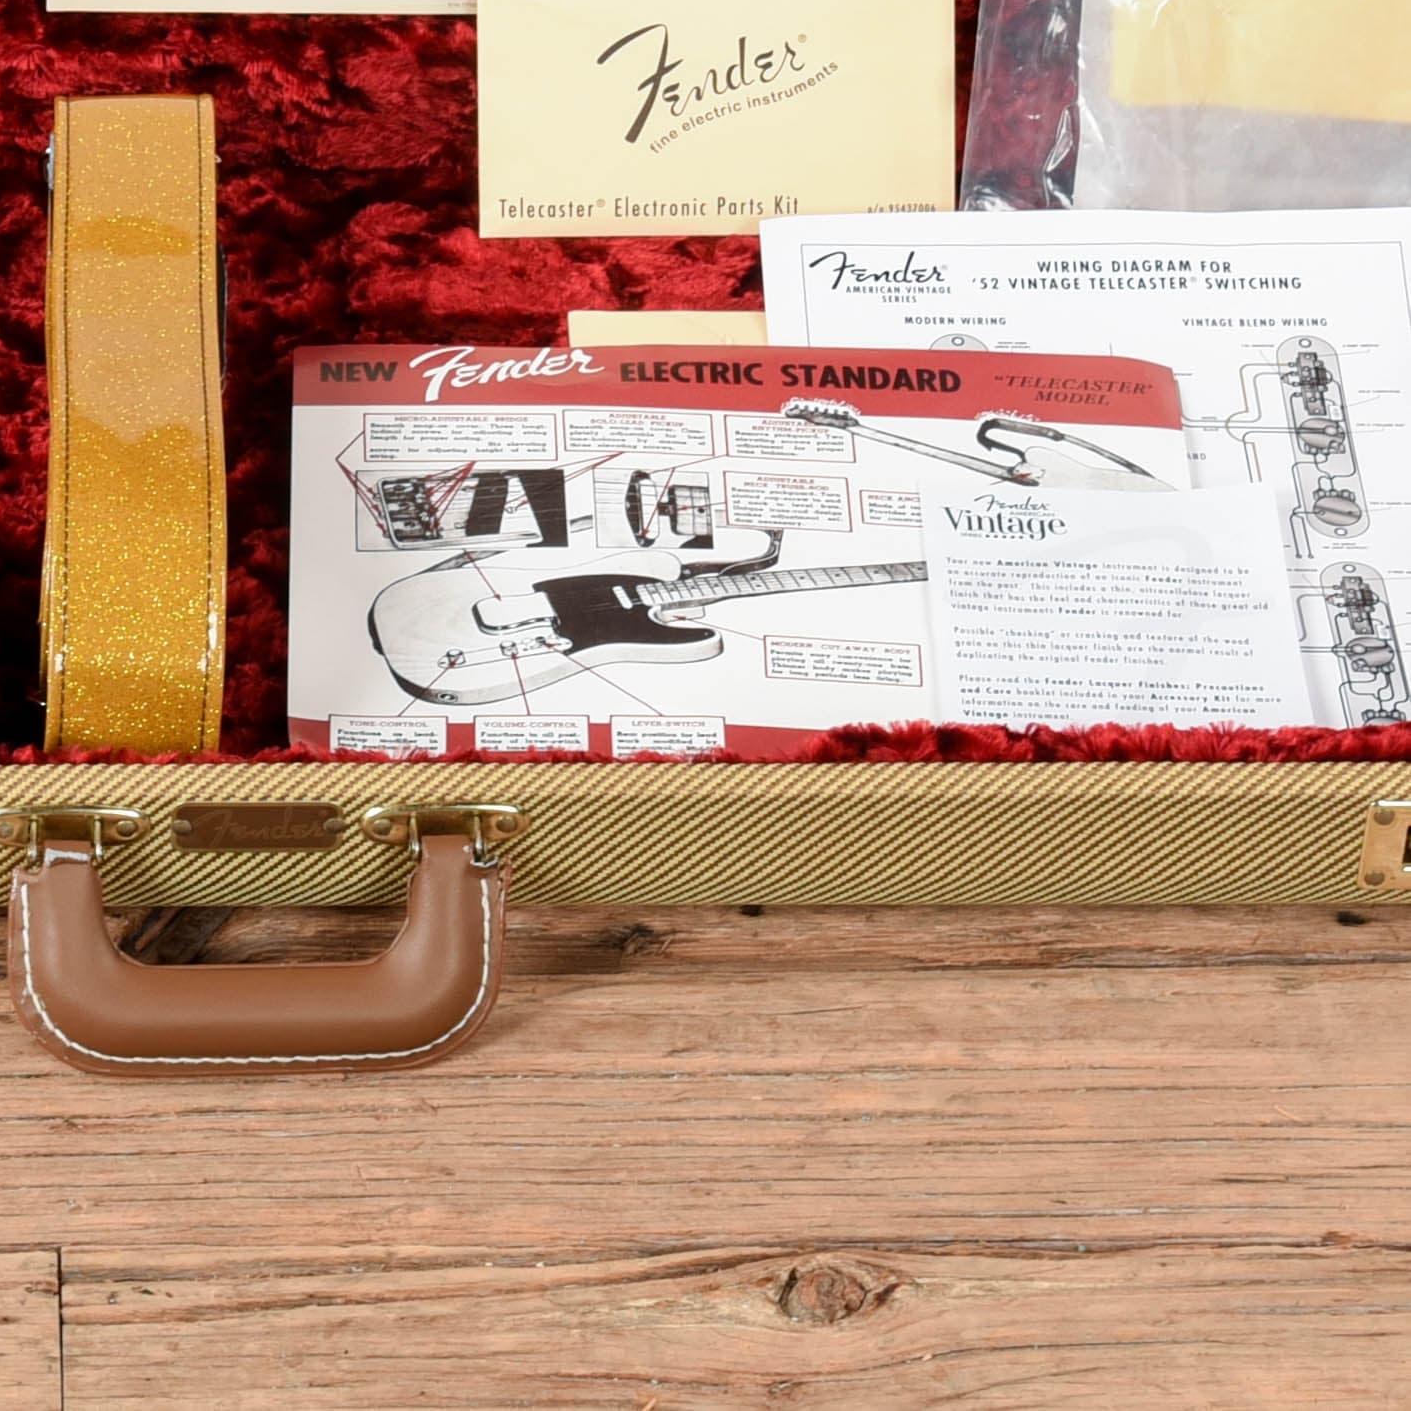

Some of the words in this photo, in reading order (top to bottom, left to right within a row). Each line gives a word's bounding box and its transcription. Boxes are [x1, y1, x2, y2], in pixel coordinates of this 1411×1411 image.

[648, 127, 678, 155] fine
[681, 99, 742, 133] electric
[746, 61, 840, 109] instruments
[613, 197, 710, 219] Electronic
[716, 196, 766, 216] Parts
[773, 196, 799, 216] Kit
[809, 251, 945, 289] Fender
[1036, 260, 1104, 273] WIRING
[1111, 259, 1193, 273] DIAGRAM
[1200, 261, 1233, 274] FOR
[845, 286, 901, 295] AMERICAN
[905, 286, 952, 295] VINTAGE
[1008, 277, 1082, 290] VINTAGE
[1205, 277, 1303, 290] SWITCHING
[882, 295, 917, 303] SERIES
[904, 316, 955, 325] MODERN
[960, 316, 1007, 326] WIRING
[1182, 317, 1234, 328] VINTAGE
[1238, 317, 1276, 328] BLEND
[1279, 317, 1328, 328] WIRING
[320, 361, 398, 382] NEW
[409, 347, 605, 404] Fender
[620, 361, 764, 386] ELECTRIC
[780, 362, 962, 394] STANDARD
[1035, 390, 1110, 406] MODEL
[973, 494, 1050, 512] Fender
[940, 506, 1068, 541] Vintage
[996, 559, 1049, 568] American
[1054, 560, 1097, 570] Vintage
[1103, 562, 1157, 572] instrument
[1174, 565, 1219, 576] designed
[964, 569, 1006, 577] accurate
[1010, 571, 1076, 580] reproduction
[1111, 574, 1140, 582] iconic
[1145, 575, 1183, 584] Fender
[1188, 577, 1242, 586] instrument
[948, 578, 972, 587] from
[1055, 584, 1096, 592] includes
[1139, 587, 1208, 597] nitrocellulose
[1213, 590, 1250, 600] lacquer
[950, 590, 979, 599] finish
[983, 591, 1003, 600] that
[1097, 596, 1170, 607] characteristics
[1190, 600, 1217, 609] those
[1221, 602, 1248, 611] great
[951, 603, 989, 612] vintage
[994, 604, 1054, 614] instruments
[1058, 607, 1096, 615] Fender
[1113, 609, 1163, 618] renowned
[954, 626, 995, 636] Possible
[1075, 631, 1118, 641] cracking
[955, 639, 982, 647] grain
[1003, 641, 1021, 649] this
[1051, 643, 1088, 652] lacquer
[1093, 644, 1122, 652] finish
[1169, 647, 1205, 655] normal
[1209, 649, 1239, 657] result
[956, 651, 1014, 661] duplicating
[1039, 654, 1080, 663] original
[959, 674, 992, 682] Please
[1045, 678, 1084, 686] Fender
[1088, 680, 1132, 689] Lacquer
[1138, 681, 1190, 690] Finishes:
[1195, 683, 1265, 691] Precautions
[986, 687, 1012, 695] Care
[1016, 688, 1055, 696] booklet
[1060, 690, 1103, 698] included
[1123, 693, 1145, 701] your
[1150, 693, 1208, 702] Accessory
[962, 698, 1023, 707] information
[1115, 704, 1154, 713] feeding
[1202, 706, 1256, 714] American
[963, 709, 1008, 719] Vintage
